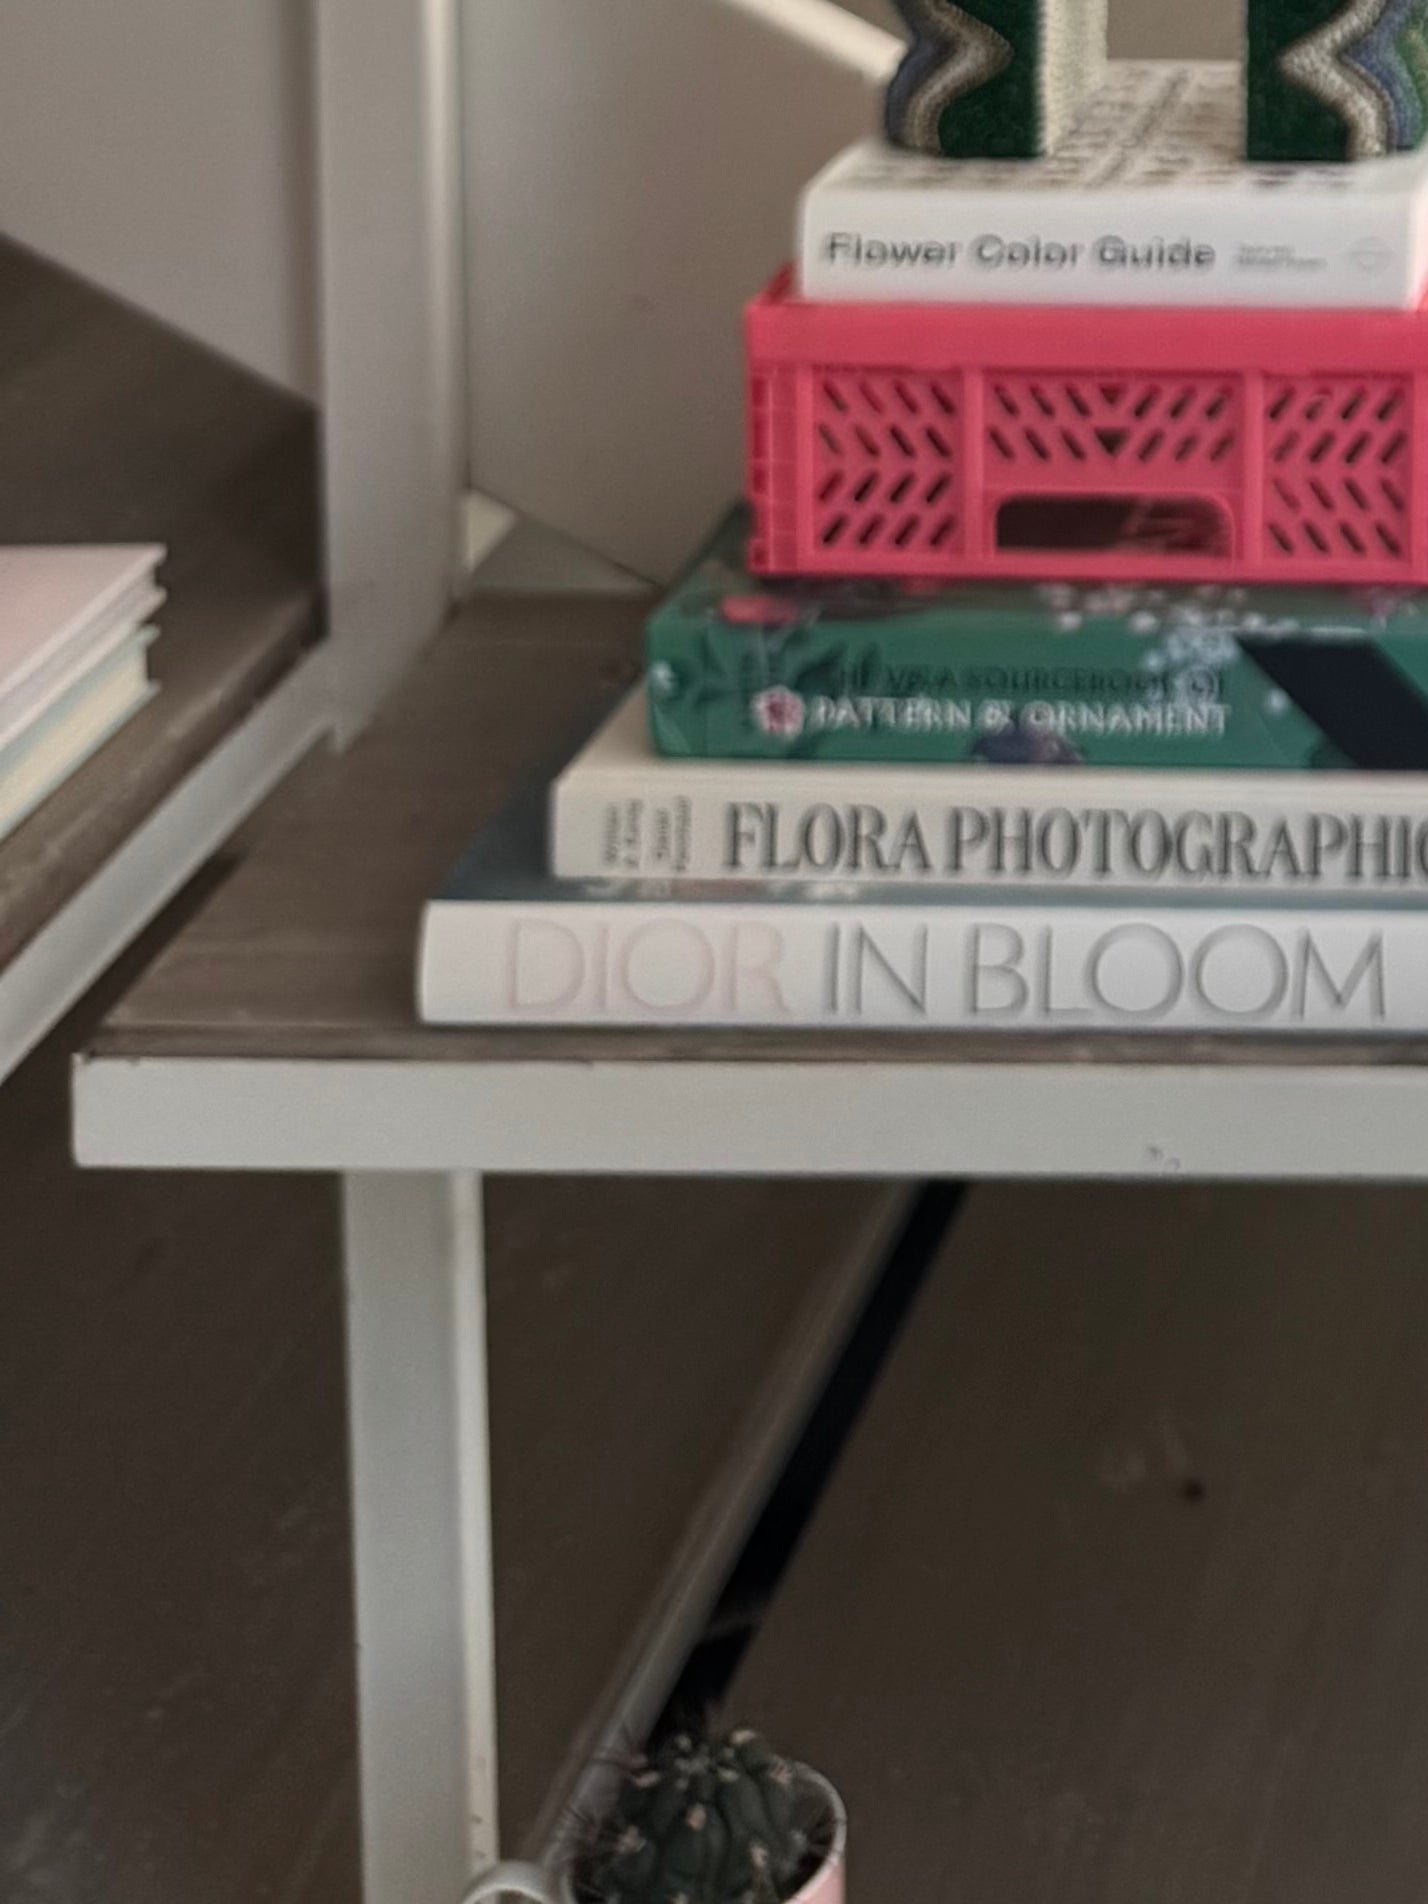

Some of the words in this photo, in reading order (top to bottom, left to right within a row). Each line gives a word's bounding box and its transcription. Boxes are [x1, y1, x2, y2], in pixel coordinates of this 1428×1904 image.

[826, 230, 961, 267] Flower
[974, 233, 1084, 269] Color
[1096, 233, 1220, 270] Guide
[814, 695, 972, 733] PATTERN
[982, 698, 1014, 732] &
[1024, 699, 1231, 736] ORNAMENT
[723, 800, 933, 874] FLORA
[505, 916, 792, 1016] DIOR
[822, 921, 928, 1017] IN
[962, 921, 1387, 1022] BLOOM
